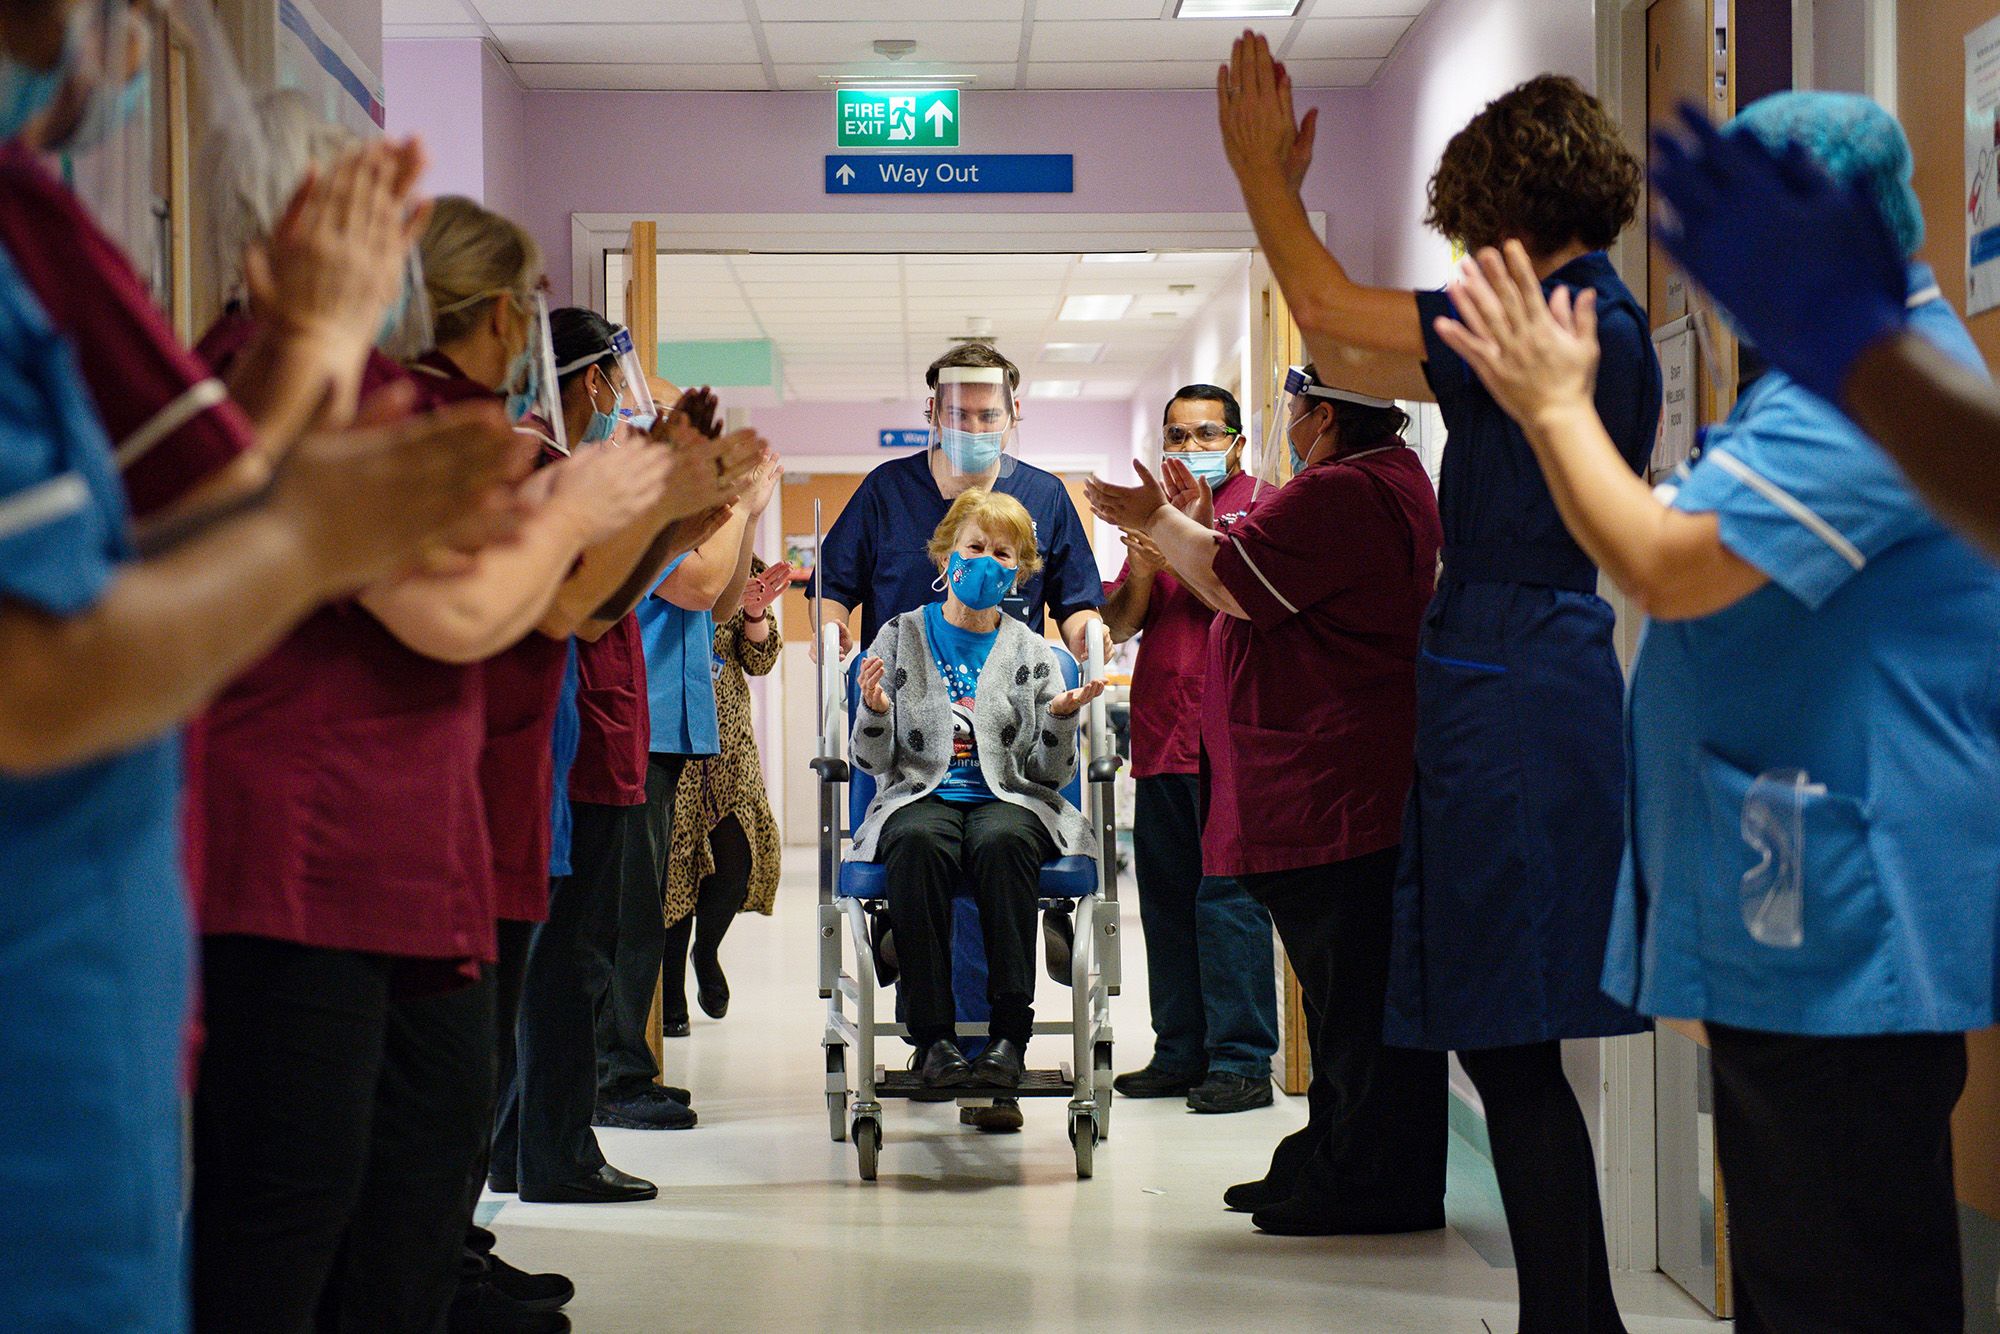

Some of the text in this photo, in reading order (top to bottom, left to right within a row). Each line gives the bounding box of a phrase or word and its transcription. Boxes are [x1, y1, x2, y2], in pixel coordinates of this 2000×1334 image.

[844, 103, 885, 118] FIRE
[845, 120, 885, 135] EXIT
[878, 163, 979, 188] Way Out
[901, 431, 928, 446] Way
